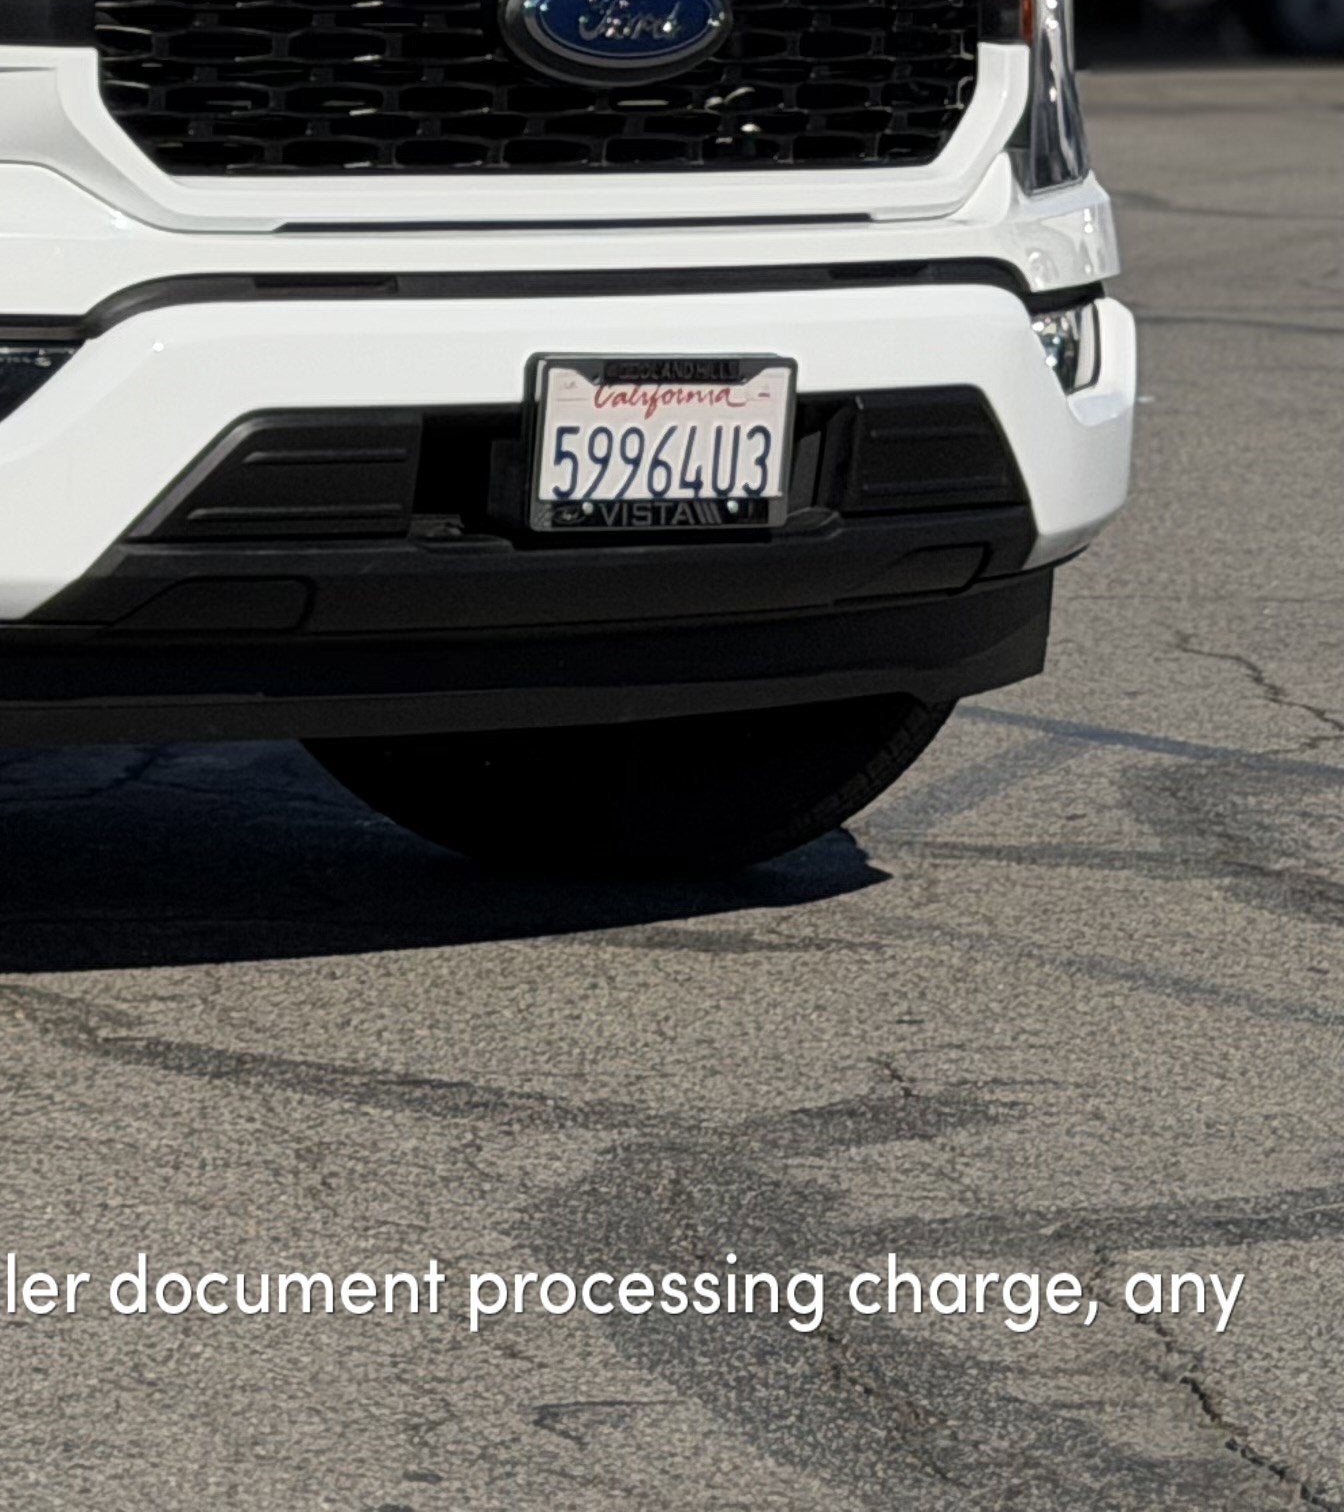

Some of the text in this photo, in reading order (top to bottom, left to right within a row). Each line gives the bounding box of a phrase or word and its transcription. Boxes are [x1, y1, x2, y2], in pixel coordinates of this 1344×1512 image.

[593, 384, 746, 420] California
[552, 424, 772, 498] 59964U3
[599, 500, 698, 526] VISTA
